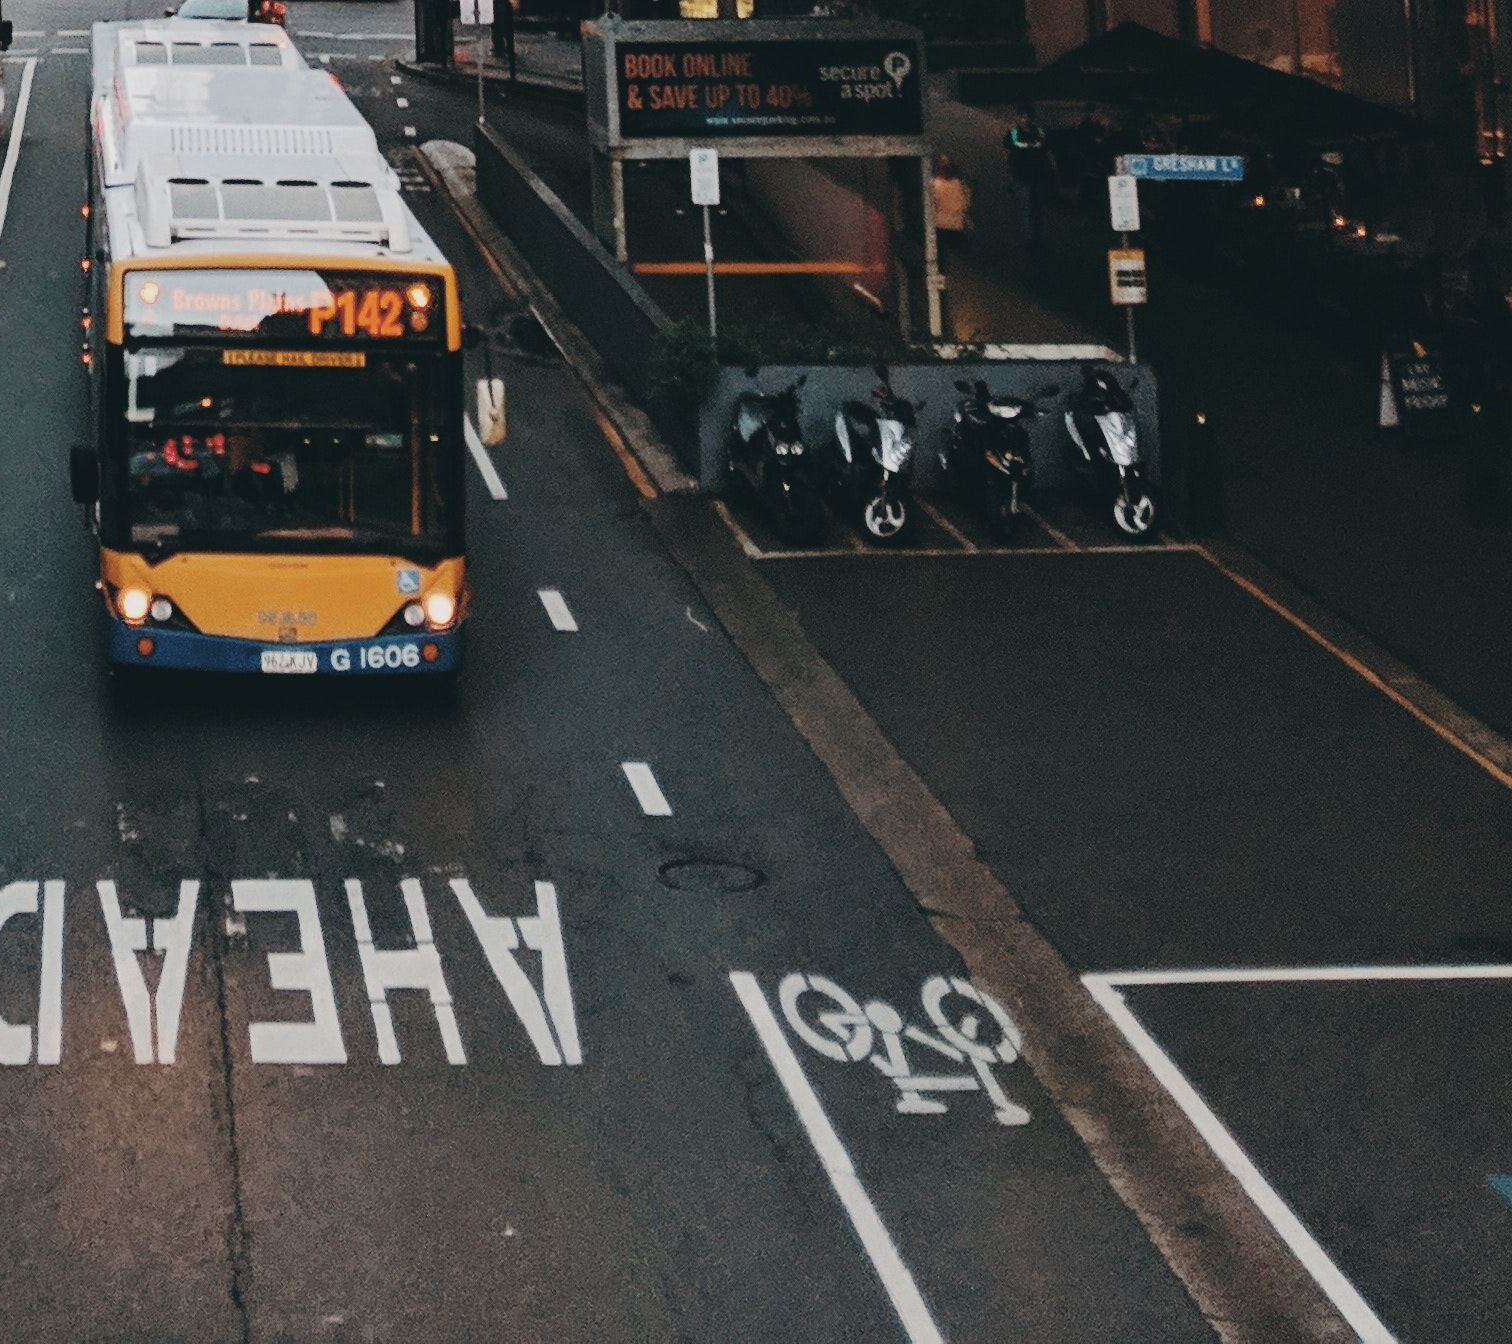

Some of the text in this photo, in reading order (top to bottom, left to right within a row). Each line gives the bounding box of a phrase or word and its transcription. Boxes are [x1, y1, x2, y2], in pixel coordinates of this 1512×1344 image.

[624, 52, 752, 79] BOOK ONLINE
[819, 65, 881, 82] secure
[627, 84, 814, 110] & SAVE UP TO 40%
[840, 84, 852, 99] a
[1153, 156, 1217, 172] GRESHAM
[172, 288, 240, 311] Browns
[308, 288, 405, 337] P142
[330, 643, 420, 672] G 1606
